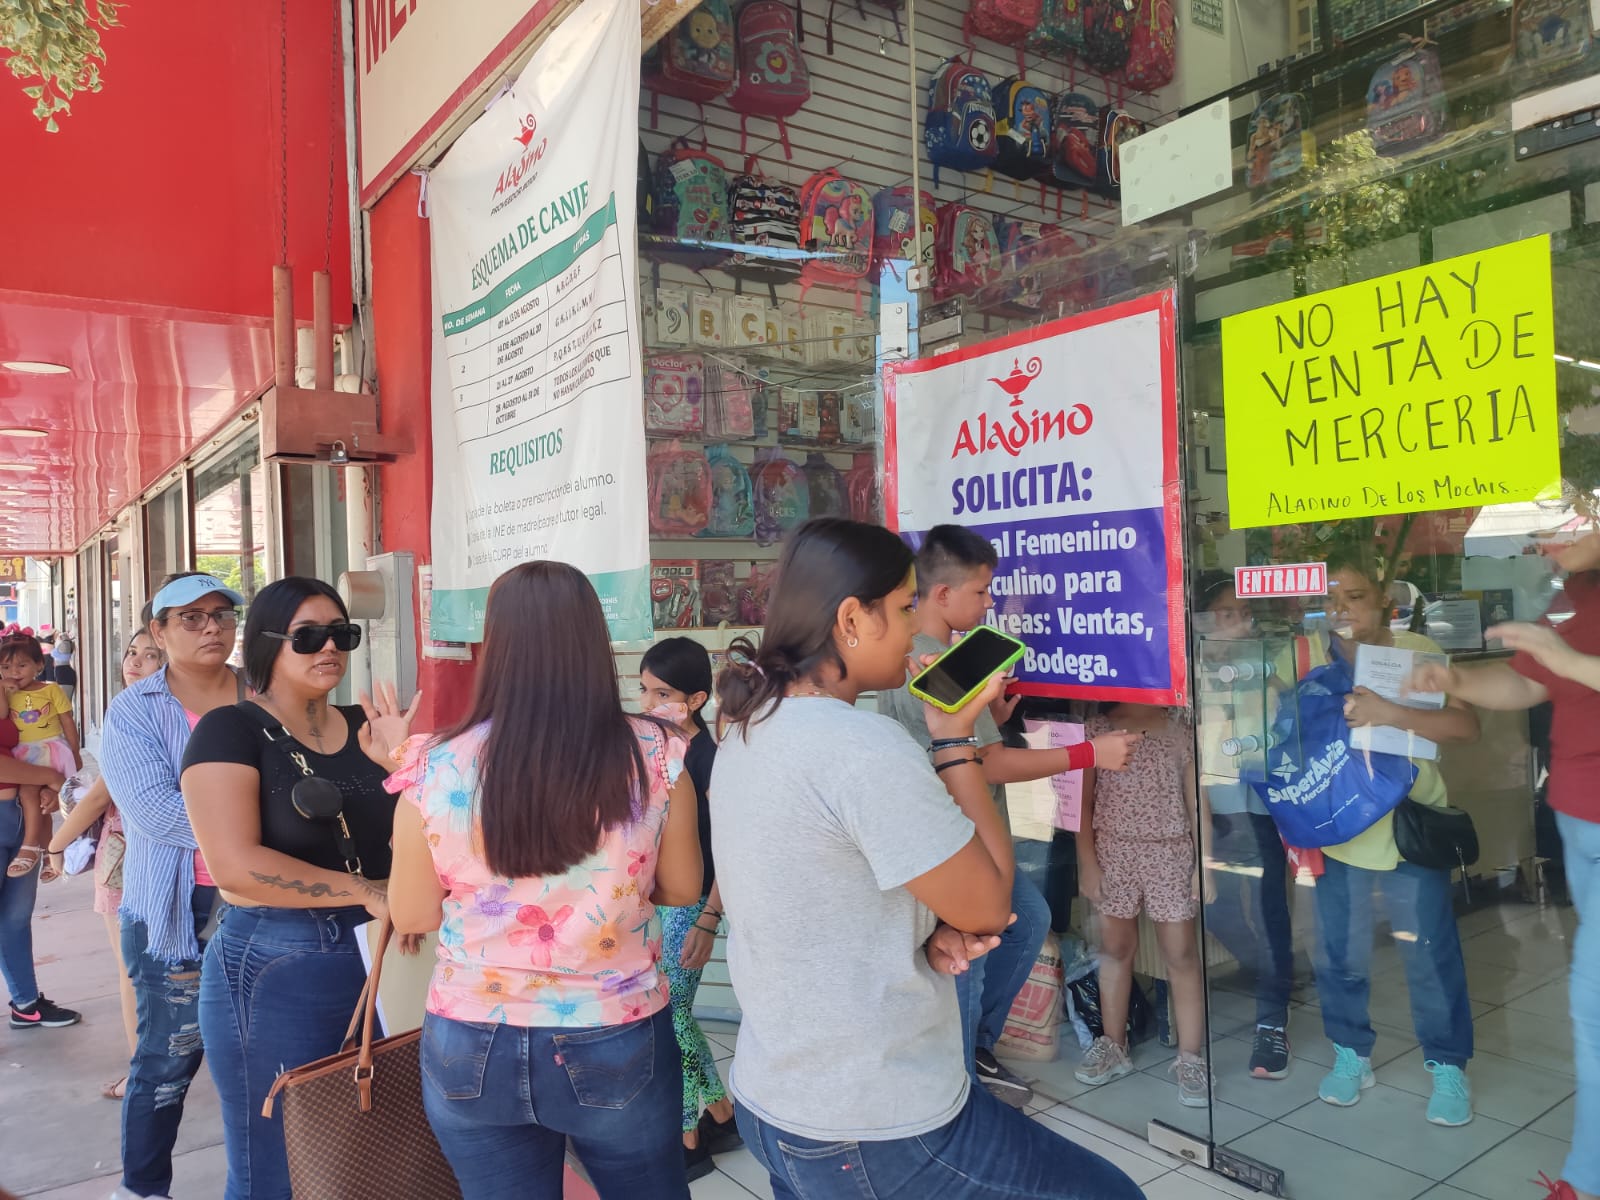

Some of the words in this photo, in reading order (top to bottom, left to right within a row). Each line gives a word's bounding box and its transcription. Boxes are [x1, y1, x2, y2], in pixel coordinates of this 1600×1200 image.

[471, 232, 519, 291] ESQUEMA
[517, 216, 539, 250] DE
[539, 180, 589, 235] CANJE
[504, 282, 522, 298] FECHA
[455, 317, 465, 327] DE
[465, 307, 486, 323] SEMANA
[520, 297, 540, 315] AGOSTO
[1275, 303, 1335, 354] NO
[1375, 260, 1482, 333] HAY
[699, 309, 715, 337] B
[741, 312, 759, 341] C
[509, 330, 529, 347] AGOSTO
[832, 326, 846, 354] F
[504, 346, 523, 362] AGOSTO
[594, 345, 612, 362] QUE
[651, 358, 683, 369] Doctor
[1261, 335, 1443, 408] VENTA
[1460, 311, 1536, 370] DE
[514, 366, 534, 382] AGOSTO
[502, 394, 521, 411] AGOSTO
[496, 409, 517, 425] OCTUBRE
[951, 402, 1095, 460] Aladino
[1285, 384, 1536, 467] MERCERIA
[489, 428, 563, 476] REQUISITOS
[493, 499, 515, 514] boleta
[574, 473, 616, 492] alumno.
[951, 461, 1095, 516] SOLICITA:
[493, 523, 506, 538] INE
[506, 522, 516, 536] de
[560, 508, 579, 523] tutor
[493, 547, 512, 561] CURP
[512, 544, 524, 559] del
[1016, 520, 1137, 557] Femenino
[1064, 569, 1122, 601] para
[1242, 567, 1322, 594] ENTRADA
[1057, 606, 1154, 642] Ventas,
[1023, 647, 1119, 683] Bodega.
